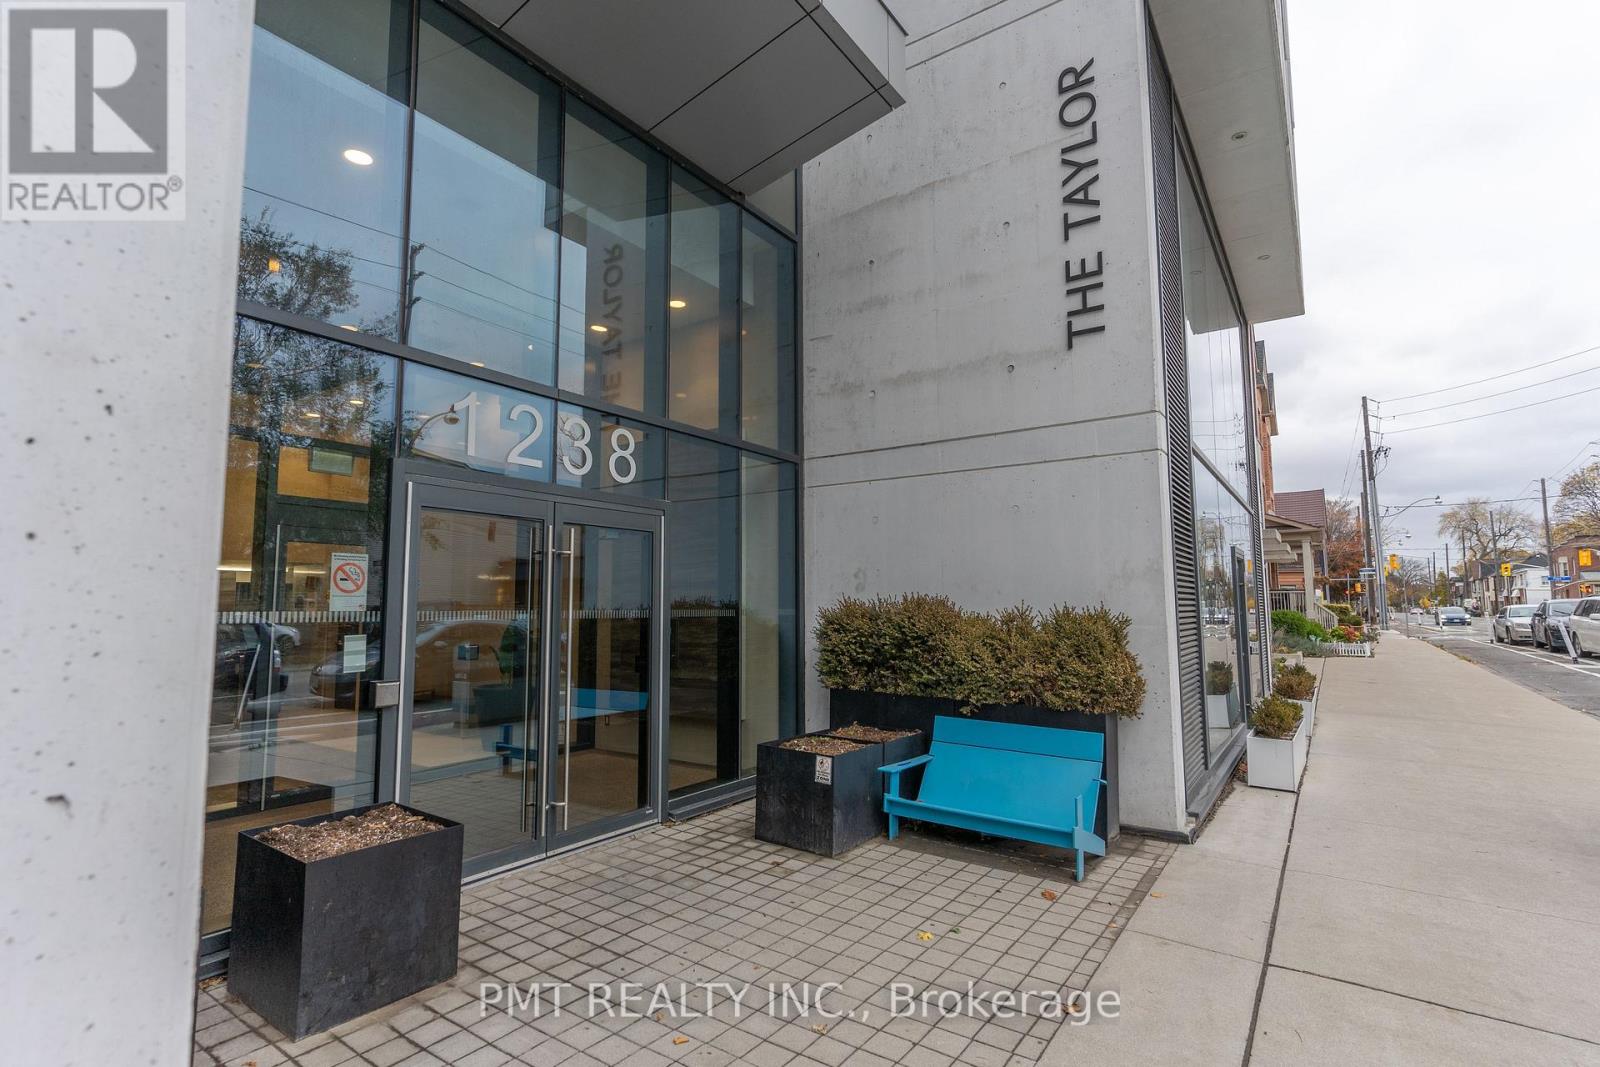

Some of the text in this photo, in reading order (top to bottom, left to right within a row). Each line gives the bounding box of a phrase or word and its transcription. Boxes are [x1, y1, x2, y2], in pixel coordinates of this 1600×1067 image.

[1058, 57, 1105, 350] THE TAYLOR
[453, 391, 637, 484] 1238
